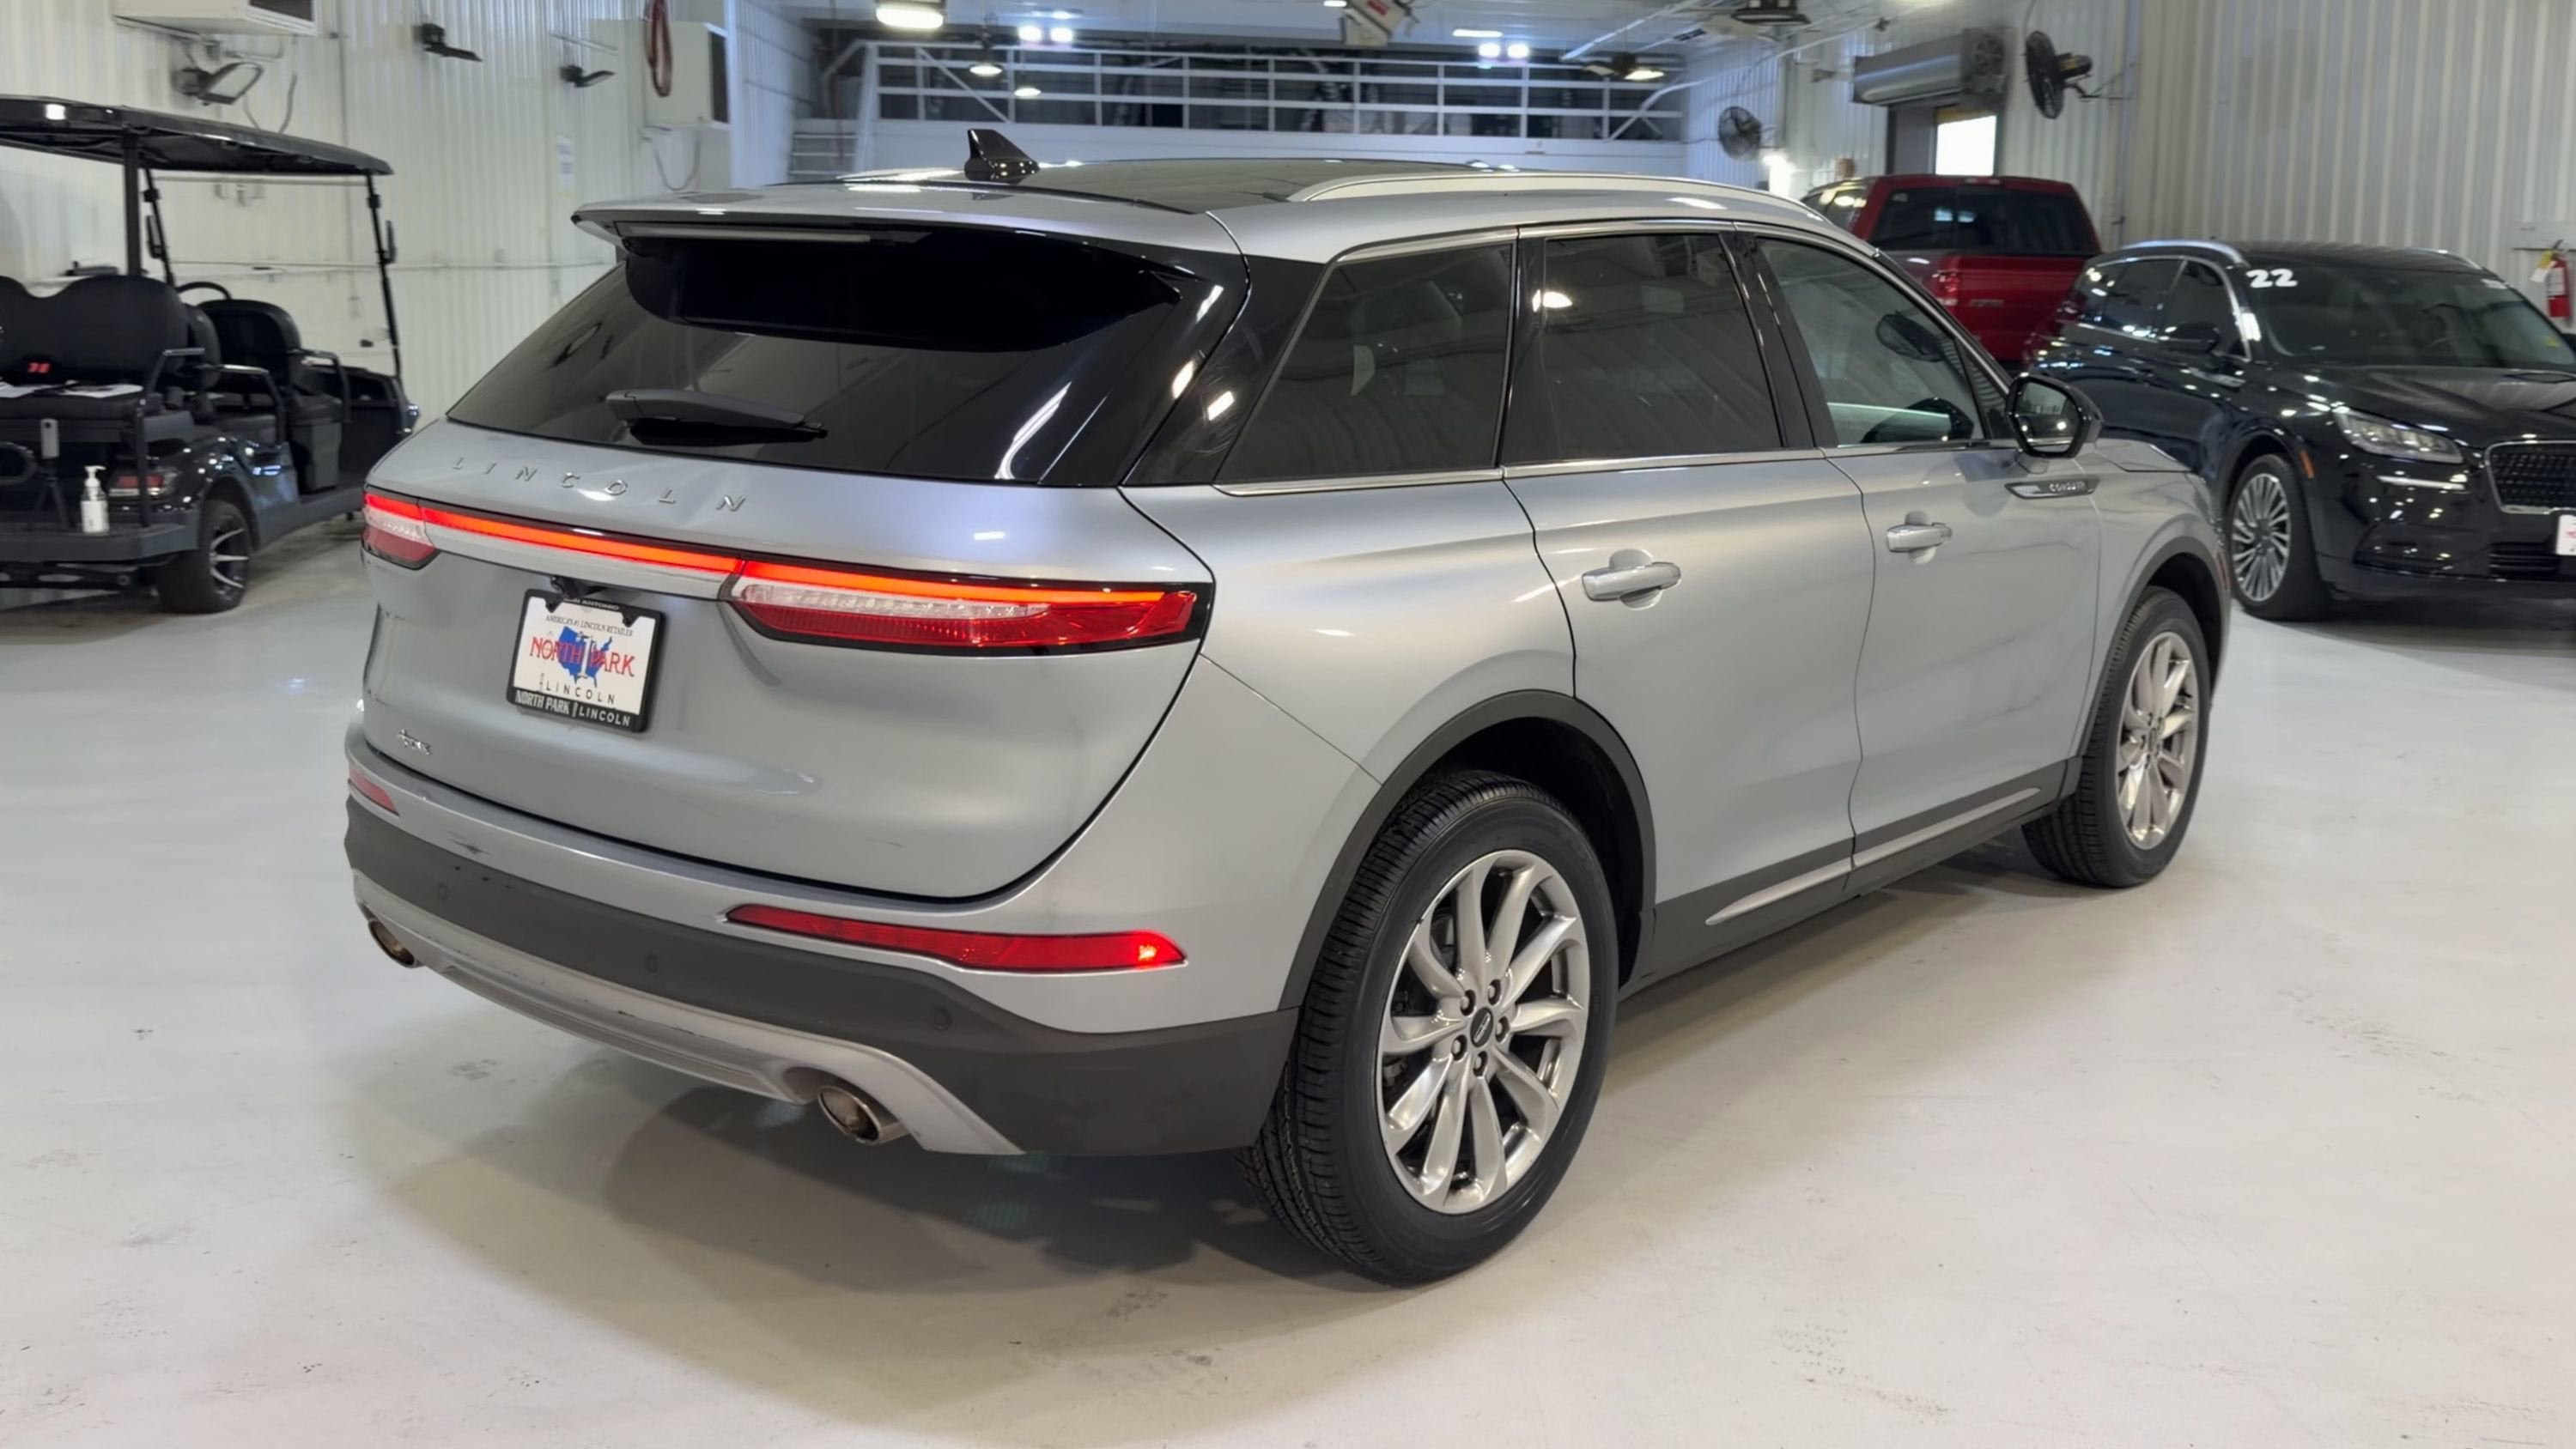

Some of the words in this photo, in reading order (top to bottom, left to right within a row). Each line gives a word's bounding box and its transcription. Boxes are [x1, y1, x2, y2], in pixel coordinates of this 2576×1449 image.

[2245, 268, 2298, 288] 22
[452, 457, 746, 512] LINCOLN
[580, 621, 605, 633] LINCOLN
[606, 624, 634, 637] RETAILER
[529, 636, 583, 665] NORTH
[589, 646, 635, 677] PARK
[515, 689, 545, 709] NORTH
[545, 696, 570, 716] PARK
[579, 706, 631, 727] LINCOLN
[546, 681, 616, 706] LINCOLN
